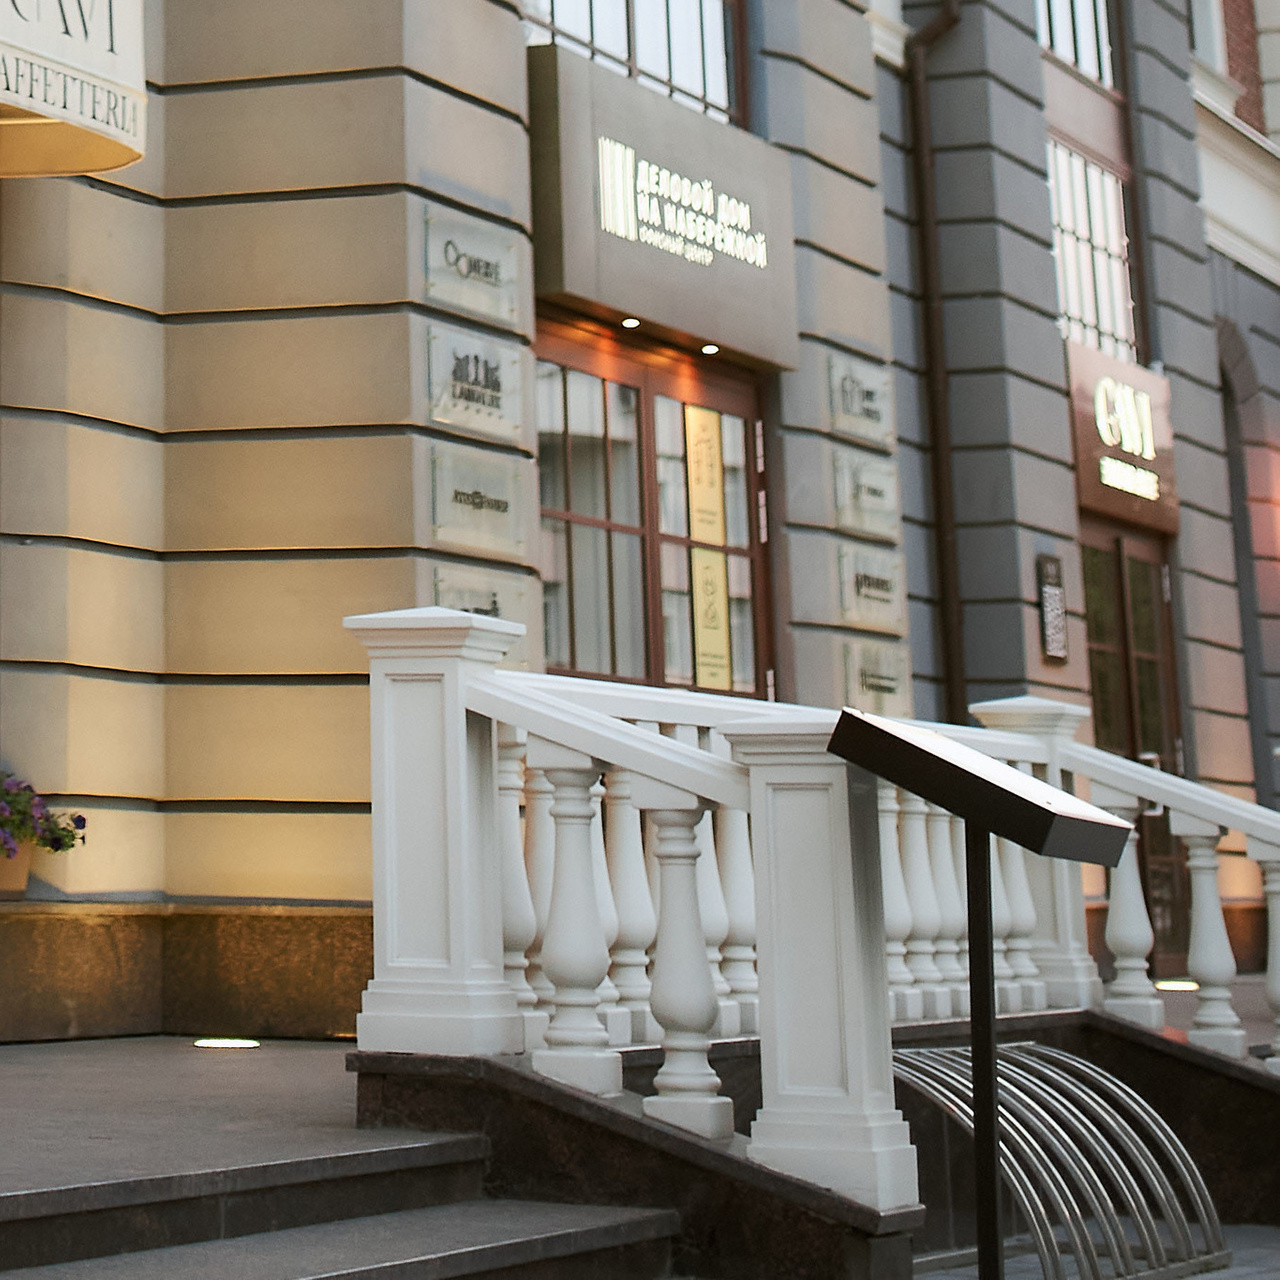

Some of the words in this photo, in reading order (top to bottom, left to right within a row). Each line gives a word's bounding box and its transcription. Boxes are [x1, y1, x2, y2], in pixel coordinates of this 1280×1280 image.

[636, 159, 715, 216] ДЕЛОВОЙ
[717, 192, 751, 232] ДОМ
[636, 193, 662, 227] НА
[663, 201, 768, 269] НАБЕРЕЖНОЙ
